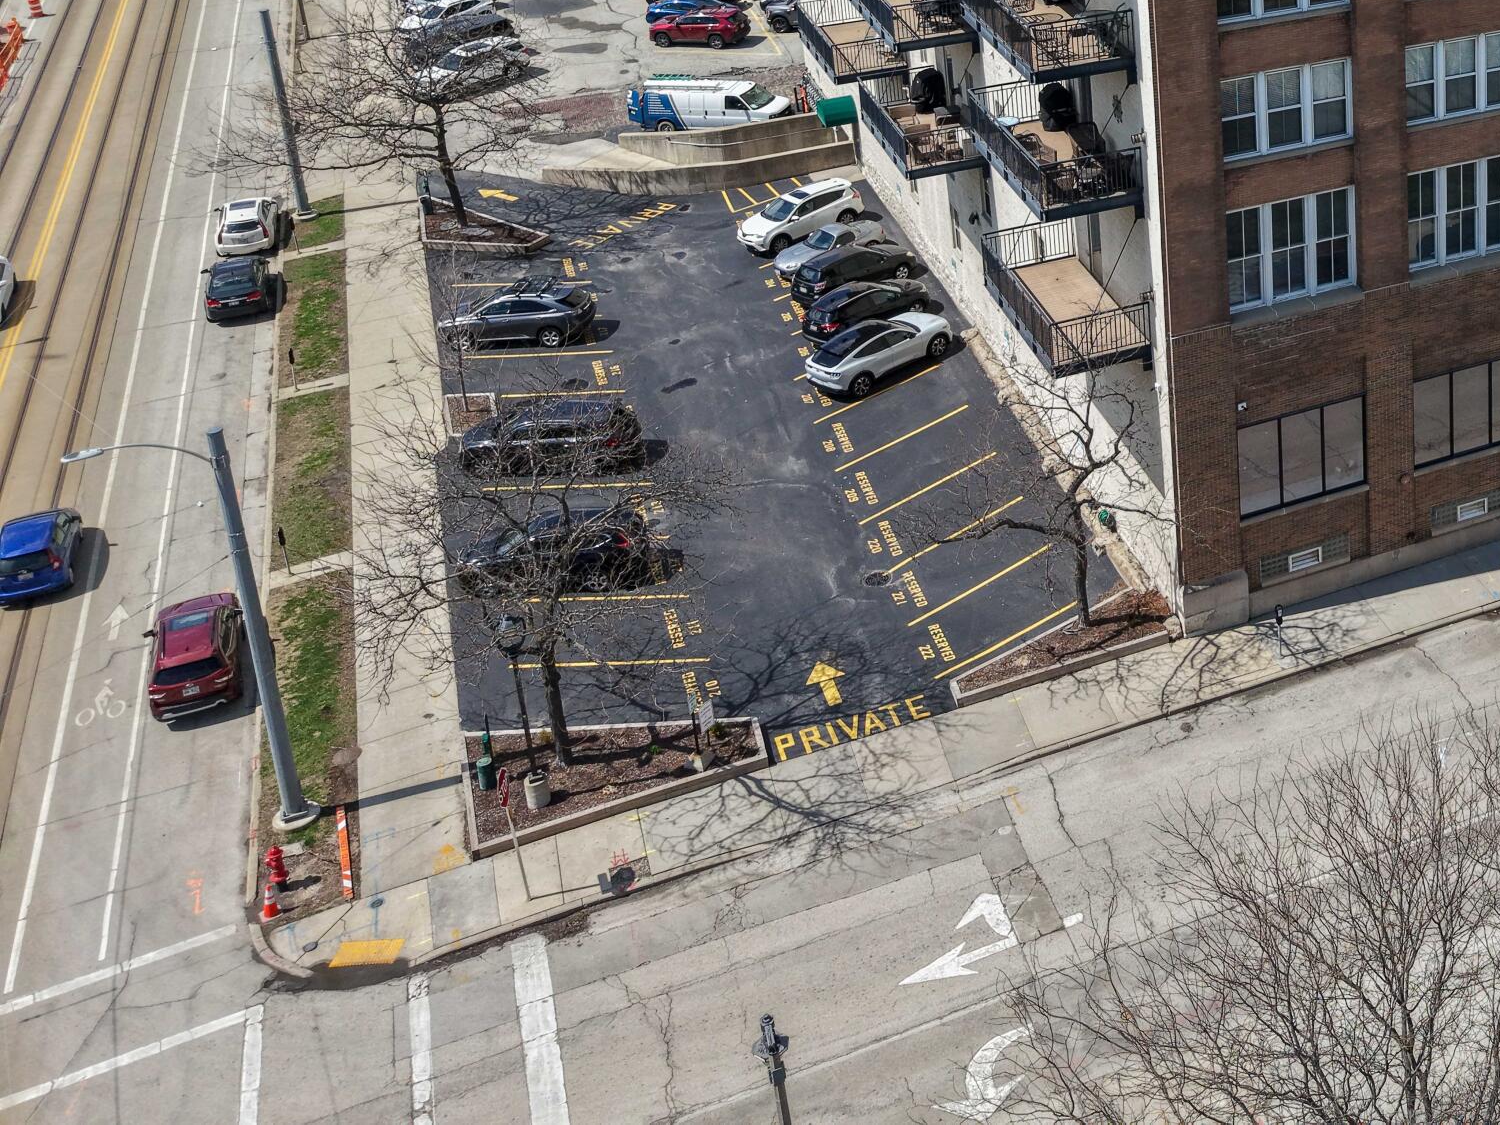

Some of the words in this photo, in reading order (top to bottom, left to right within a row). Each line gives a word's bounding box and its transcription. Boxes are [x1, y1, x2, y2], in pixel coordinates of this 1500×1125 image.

[822, 439, 836, 453] 208
[831, 422, 855, 453] RESERVED
[844, 488, 859, 503] 209
[855, 471, 879, 505] RESERVED
[867, 538, 883, 554] 220
[877, 520, 903, 557] RESERVED
[891, 591, 908, 606] 221
[901, 570, 928, 608] RESERVED
[686, 619, 703, 636] 211
[918, 644, 936, 660] 222
[927, 623, 956, 662] RESERVED
[705, 679, 722, 698] 210
[774, 694, 932, 762] PRIVATE
